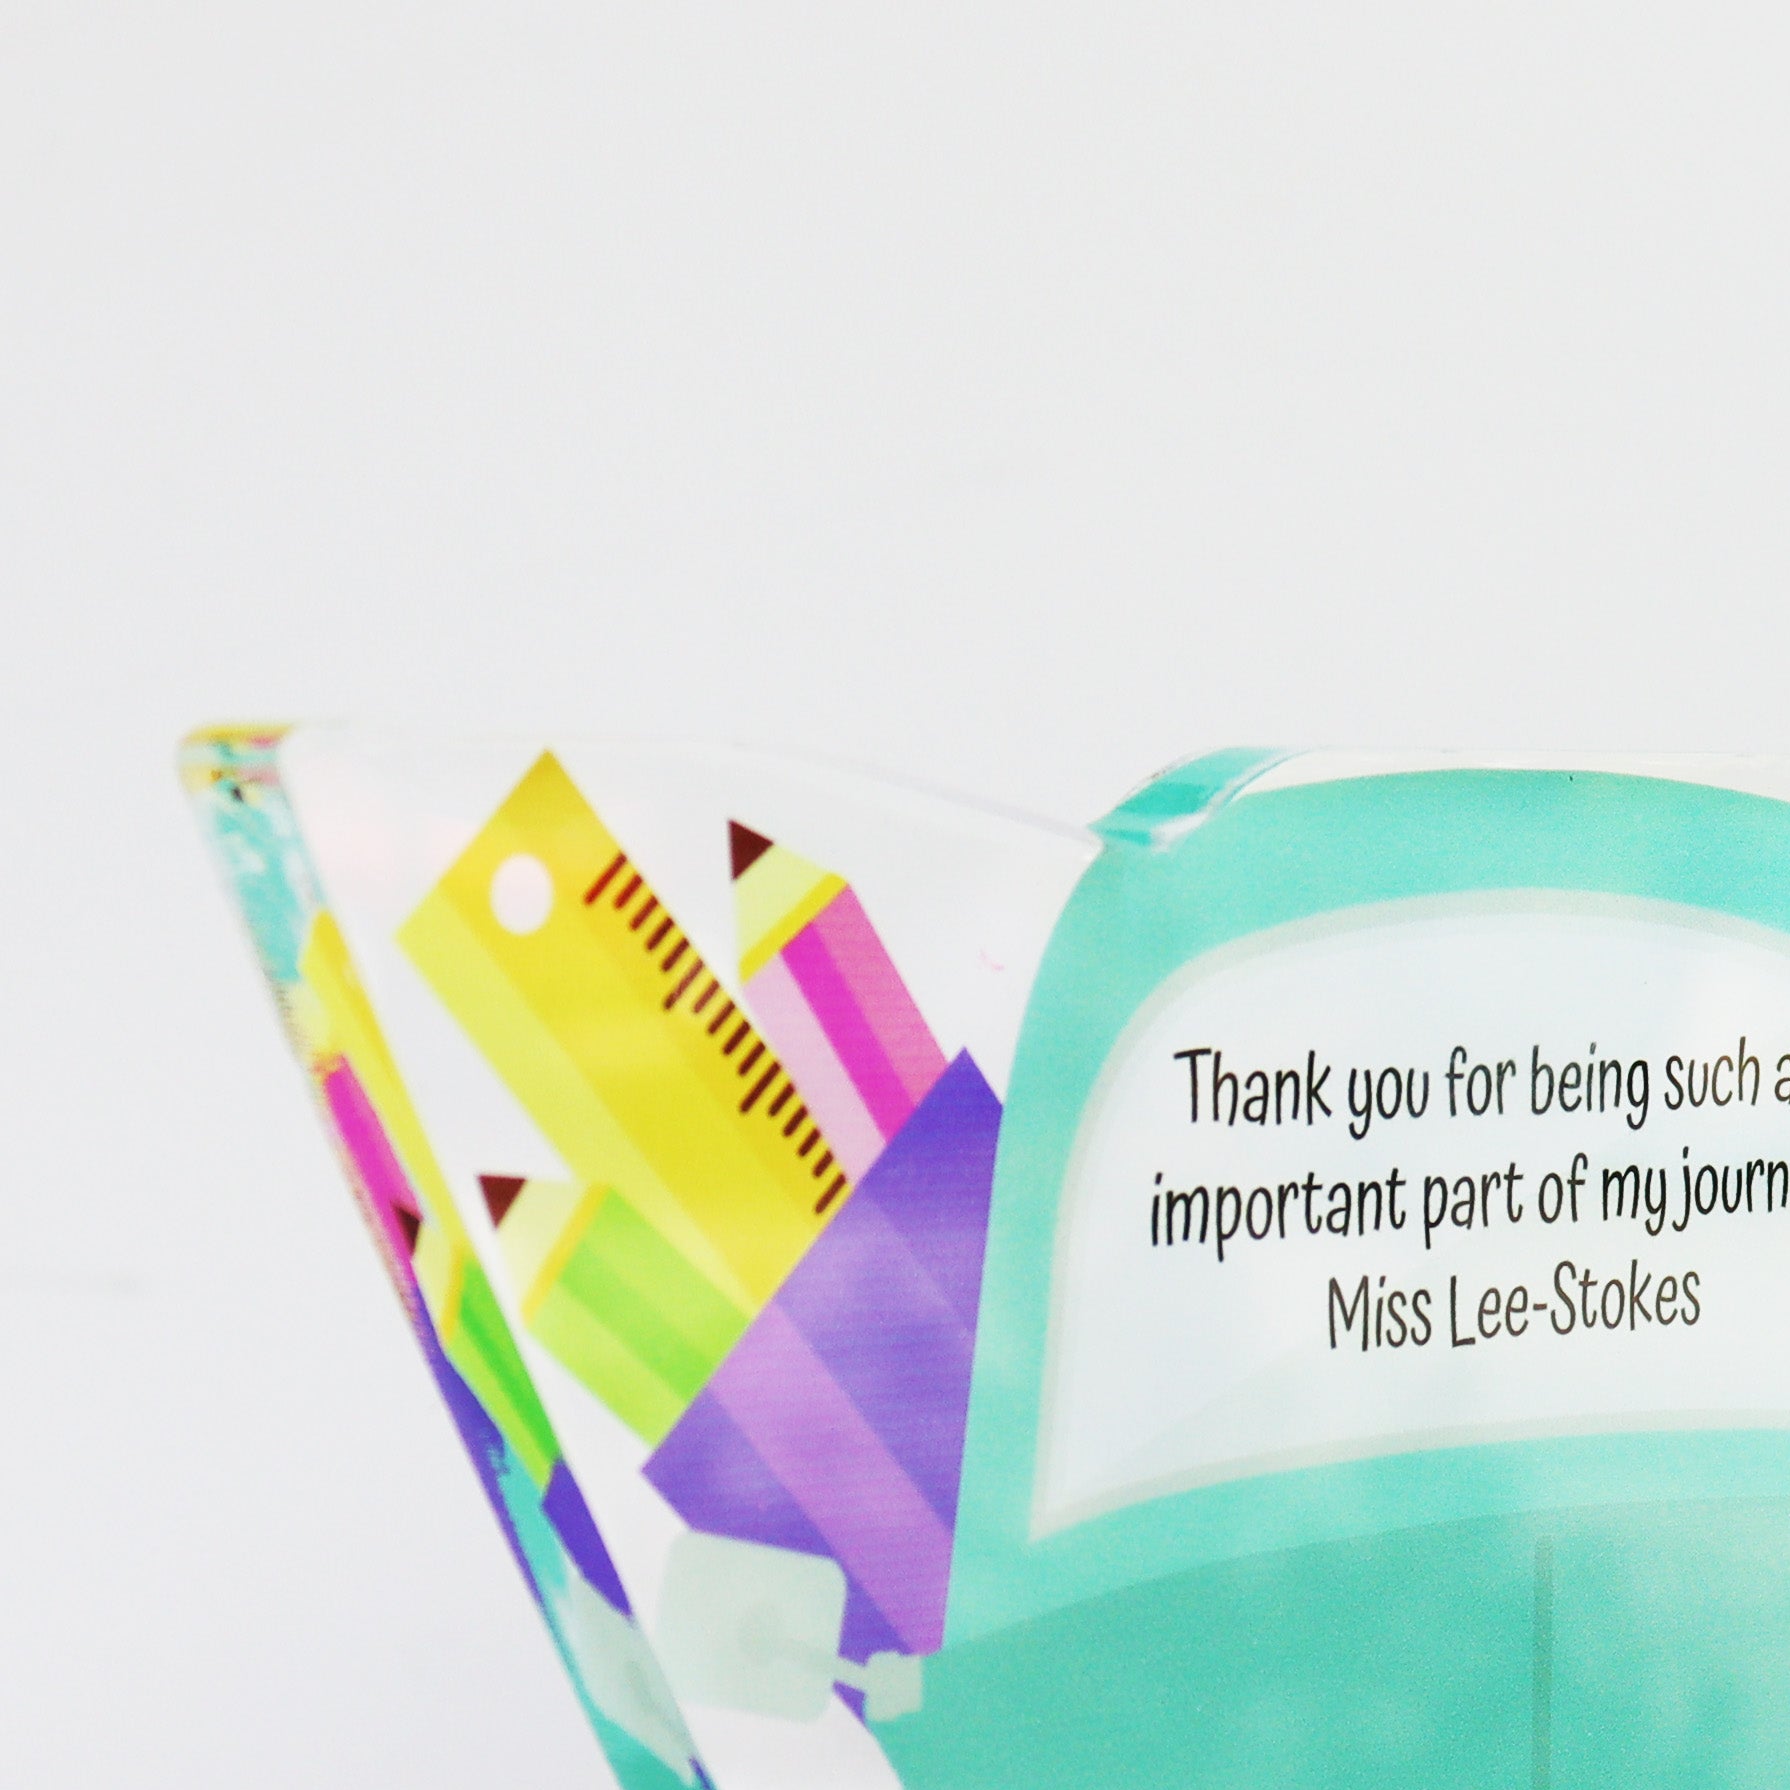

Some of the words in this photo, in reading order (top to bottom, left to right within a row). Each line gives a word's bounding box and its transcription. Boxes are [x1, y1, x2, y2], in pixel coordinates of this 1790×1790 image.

[1173, 1047, 1332, 1127] Thank
[1348, 1066, 1429, 1141] you
[1445, 1045, 1517, 1117] for
[1531, 1042, 1650, 1131] being
[1664, 1036, 1760, 1111] such
[1151, 1167, 1407, 1263] important
[1423, 1162, 1524, 1250] part
[1538, 1152, 1589, 1224] of
[1602, 1164, 1667, 1237] my
[1328, 1275, 1432, 1352] Miss
[1450, 1259, 1701, 1348] Lee-Stokes
